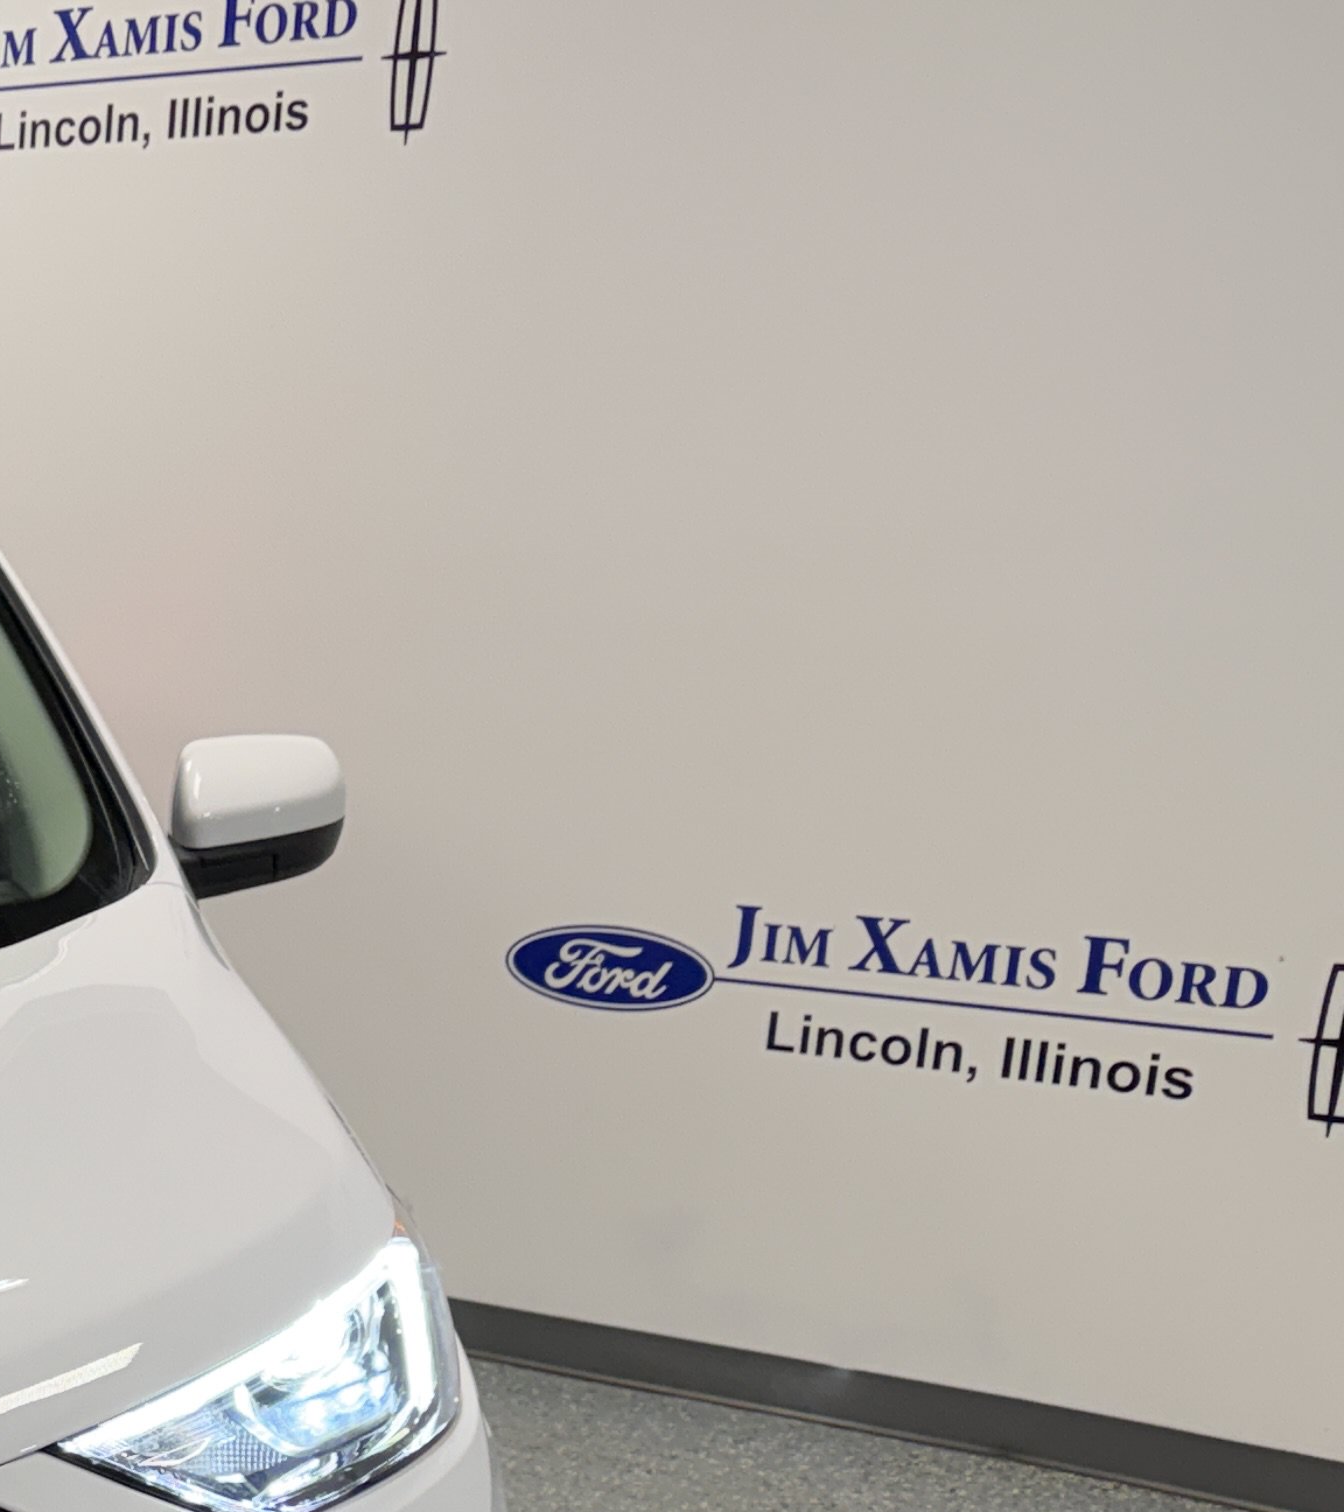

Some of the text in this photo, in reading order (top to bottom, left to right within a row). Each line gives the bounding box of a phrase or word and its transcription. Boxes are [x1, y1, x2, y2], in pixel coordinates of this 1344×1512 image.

[49, 7, 203, 63] XAMIS
[216, 0, 358, 47] FORD
[167, 91, 309, 139] Illinois
[544, 938, 669, 1000] Ford
[727, 904, 1269, 1009] JIM XAMIS FORD
[765, 1010, 1194, 1100] Lincoln, Illinois
